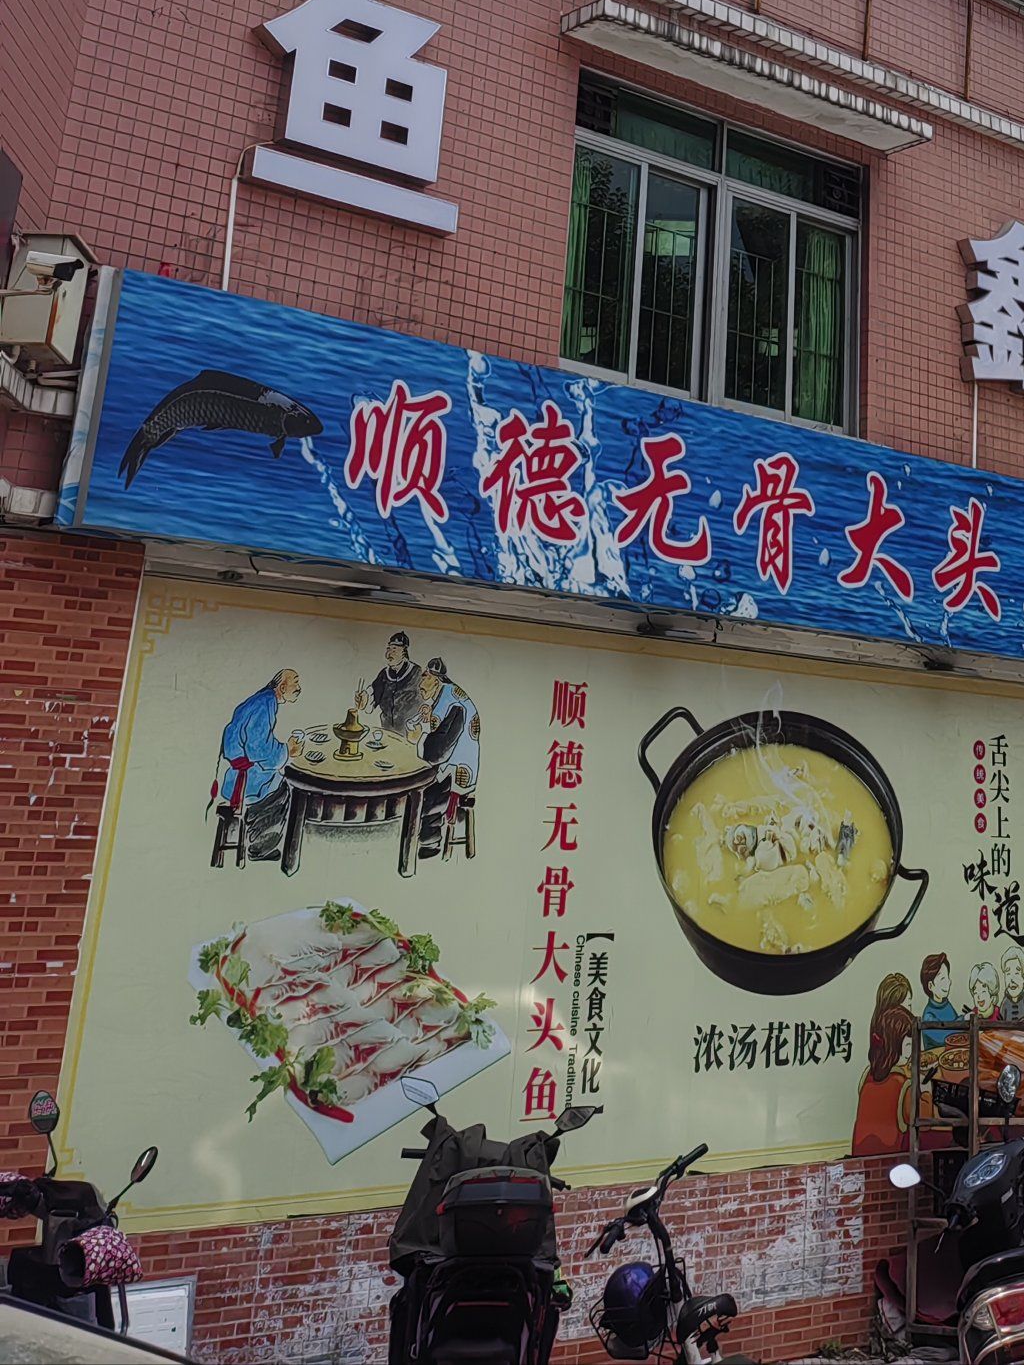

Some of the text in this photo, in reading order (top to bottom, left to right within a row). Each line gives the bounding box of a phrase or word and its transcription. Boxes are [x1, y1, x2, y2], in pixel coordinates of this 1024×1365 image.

[974, 743, 986, 828] 传统美食
[519, 680, 588, 1122] 顺德无骨大头鱼
[564, 935, 585, 1109] Chinese cuisine Traditiona
[693, 1018, 853, 1074] 浓汤花胶鸡
